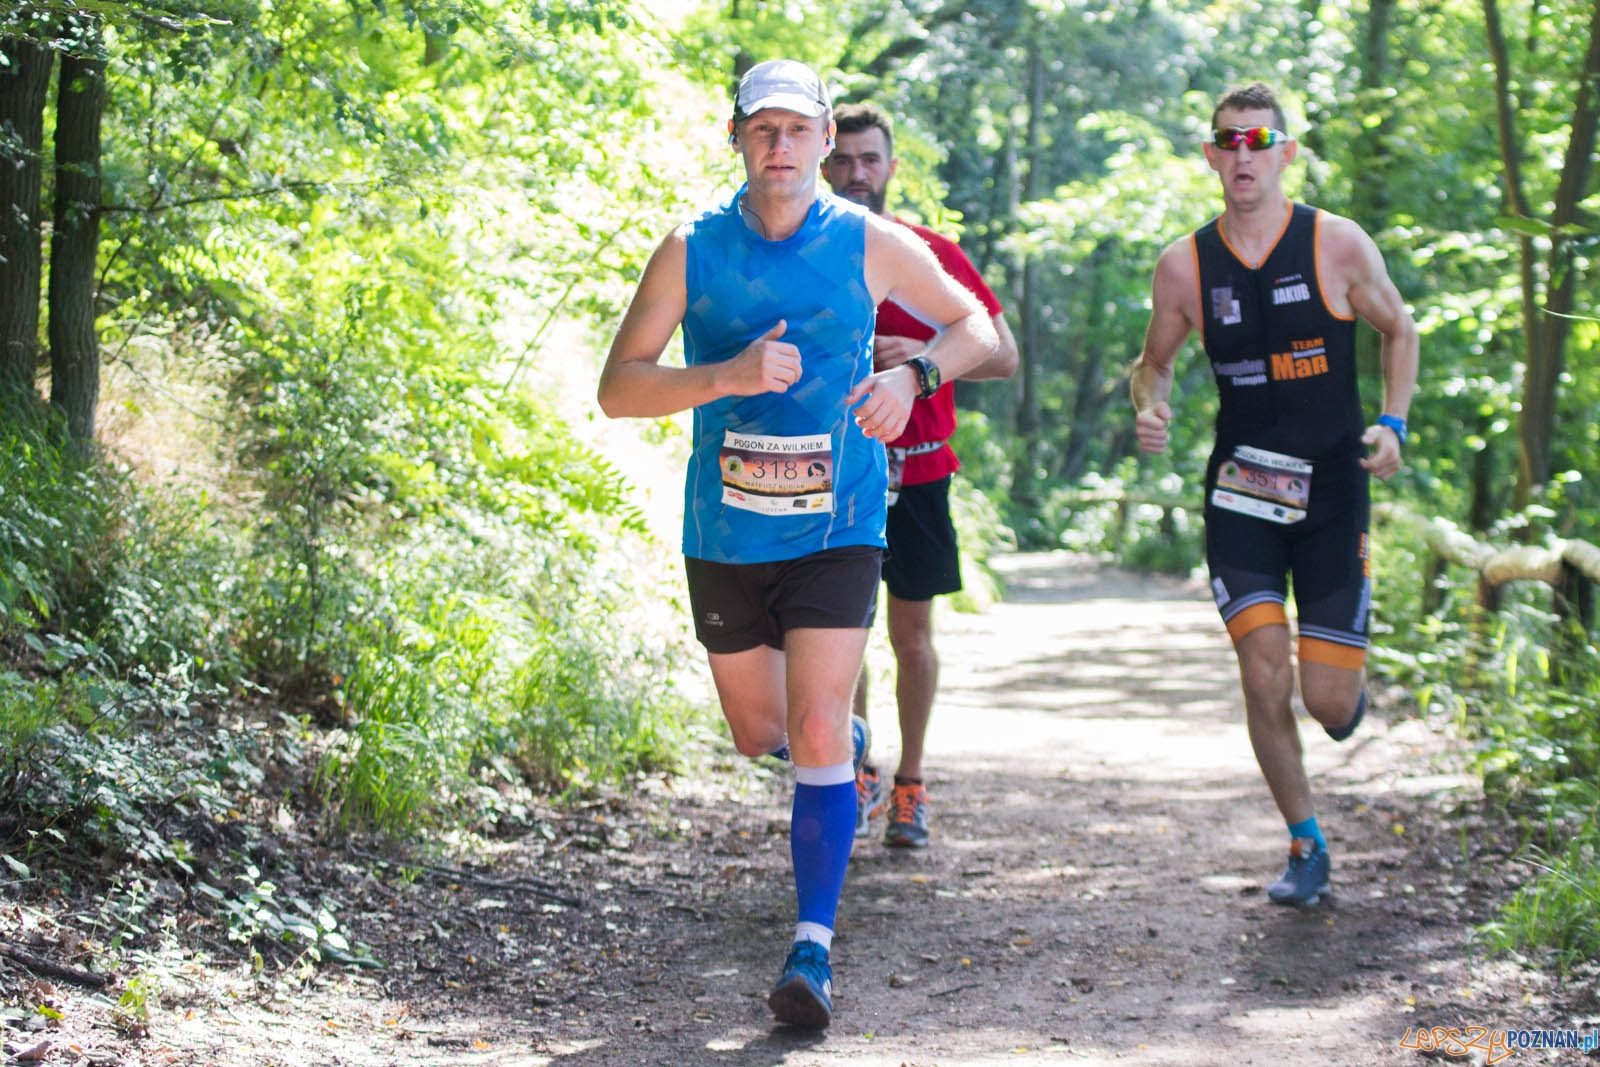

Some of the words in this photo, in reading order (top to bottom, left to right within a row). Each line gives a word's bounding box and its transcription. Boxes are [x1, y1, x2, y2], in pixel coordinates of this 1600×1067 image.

[1272, 283, 1310, 305] JAKUB
[1291, 337, 1324, 351] TEAM
[1270, 352, 1329, 381] Man
[767, 443, 780, 451] ZA
[782, 441, 823, 451] WILKIEM
[752, 459, 798, 480] 318
[1246, 470, 1277, 490] 351
